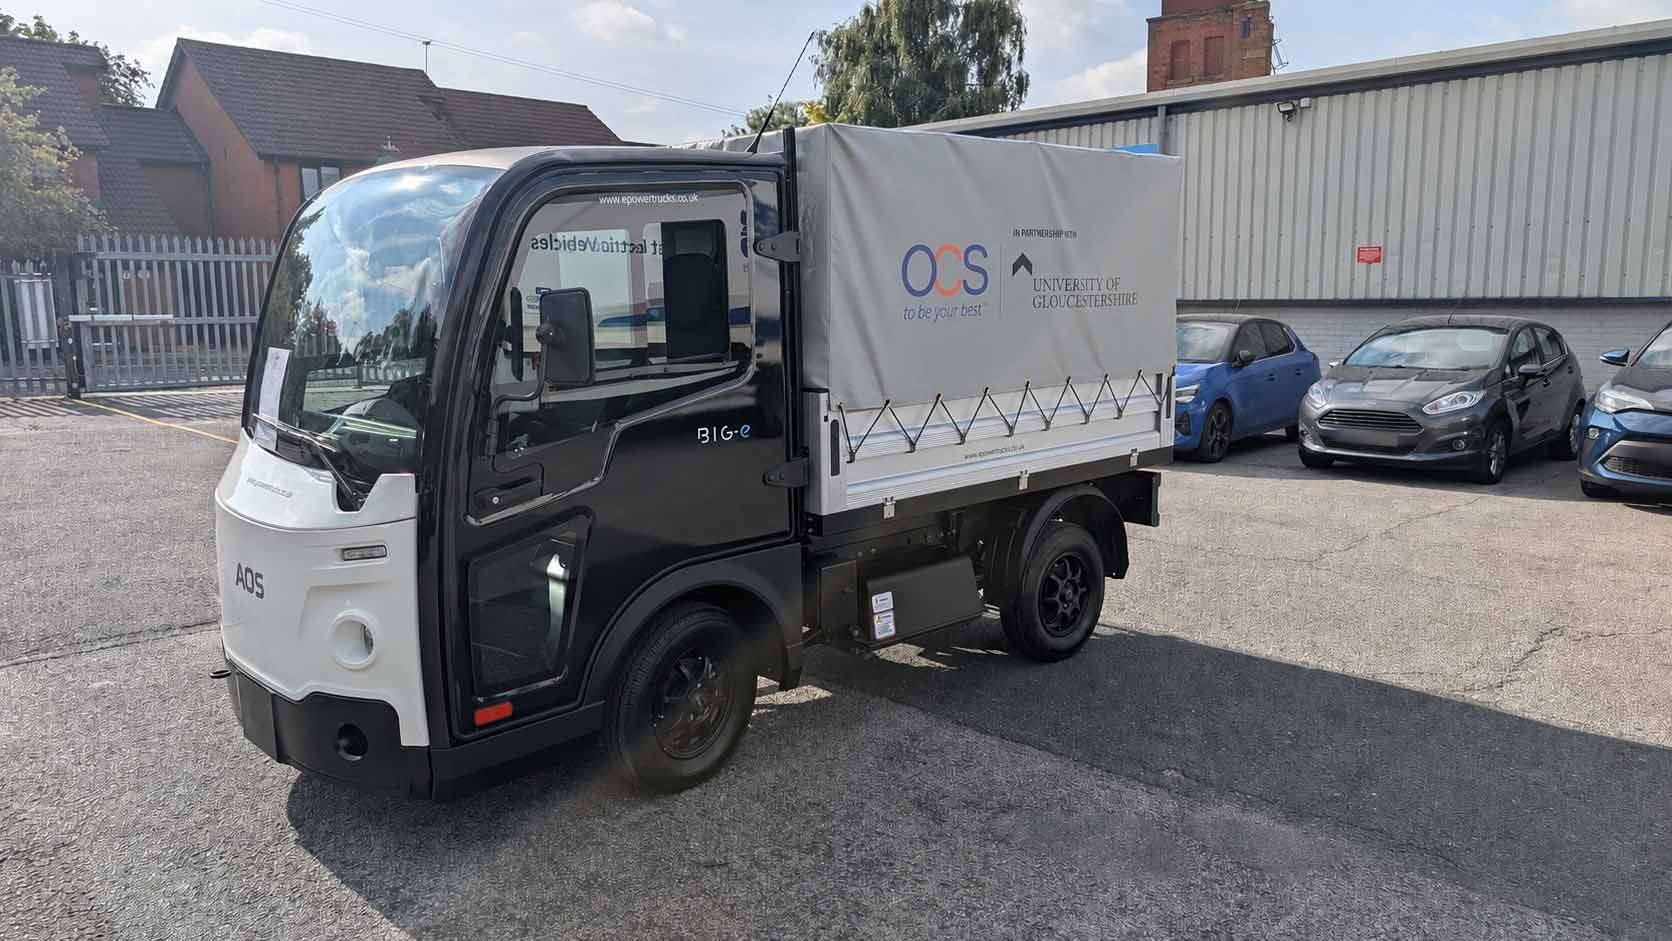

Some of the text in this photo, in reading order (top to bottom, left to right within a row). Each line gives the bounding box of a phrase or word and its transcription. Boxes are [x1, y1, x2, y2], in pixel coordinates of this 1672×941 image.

[1013, 229, 1020, 237] IN
[1021, 229, 1063, 239] PARTNERSHIP
[901, 244, 989, 297] OCS
[1032, 276, 1121, 292] UNIVERSITY OF
[1032, 291, 1138, 309] GLOUCESTERSHIRE
[903, 303, 983, 323] to be your best
[235, 563, 265, 600] AOS
